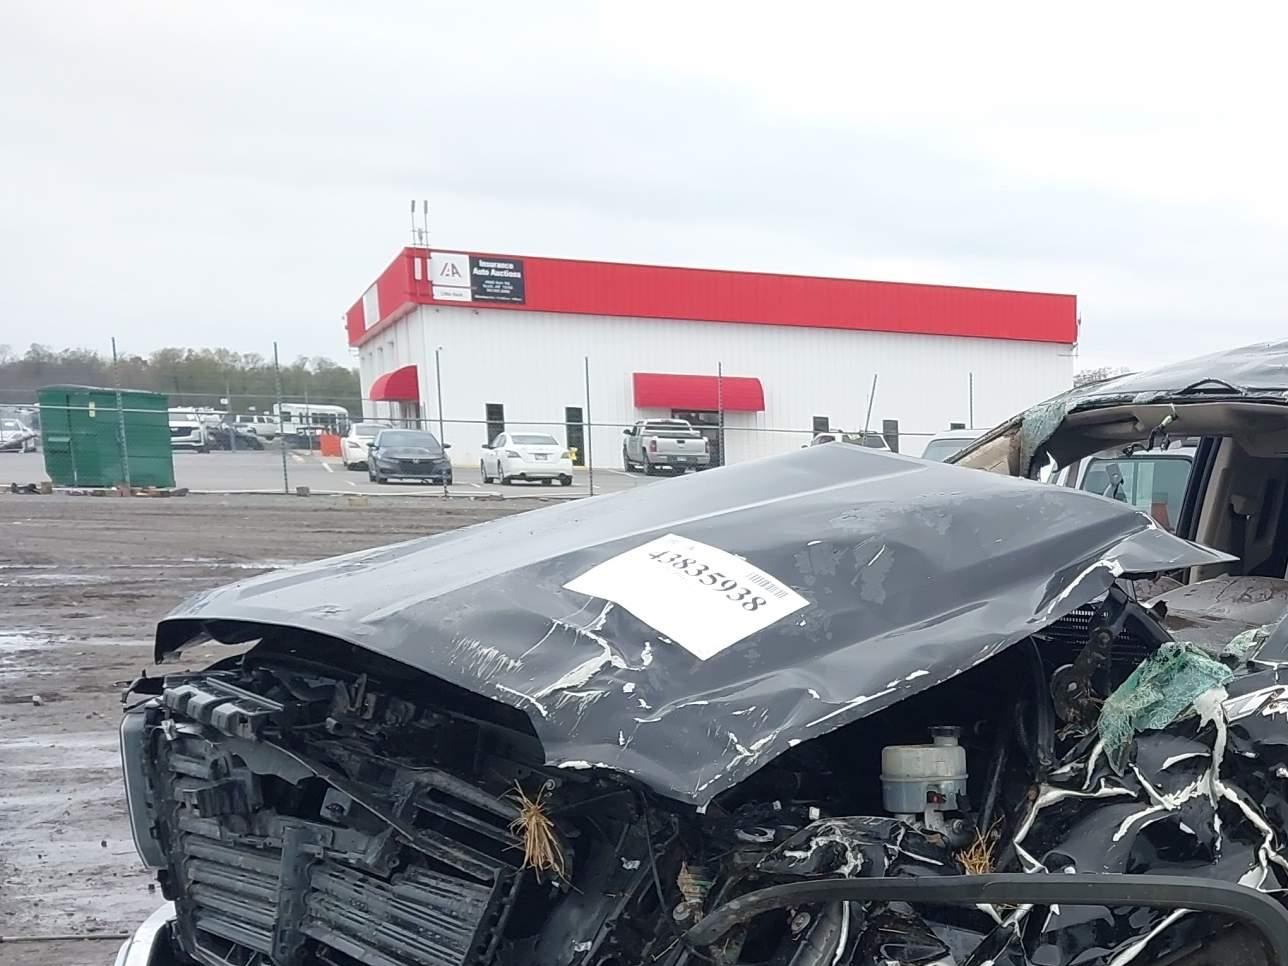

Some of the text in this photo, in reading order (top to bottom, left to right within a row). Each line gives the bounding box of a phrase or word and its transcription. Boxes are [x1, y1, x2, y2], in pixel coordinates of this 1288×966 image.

[479, 259, 514, 270] Insurance
[472, 267, 521, 278] Auto Auctions
[648, 550, 767, 611] 43835938
